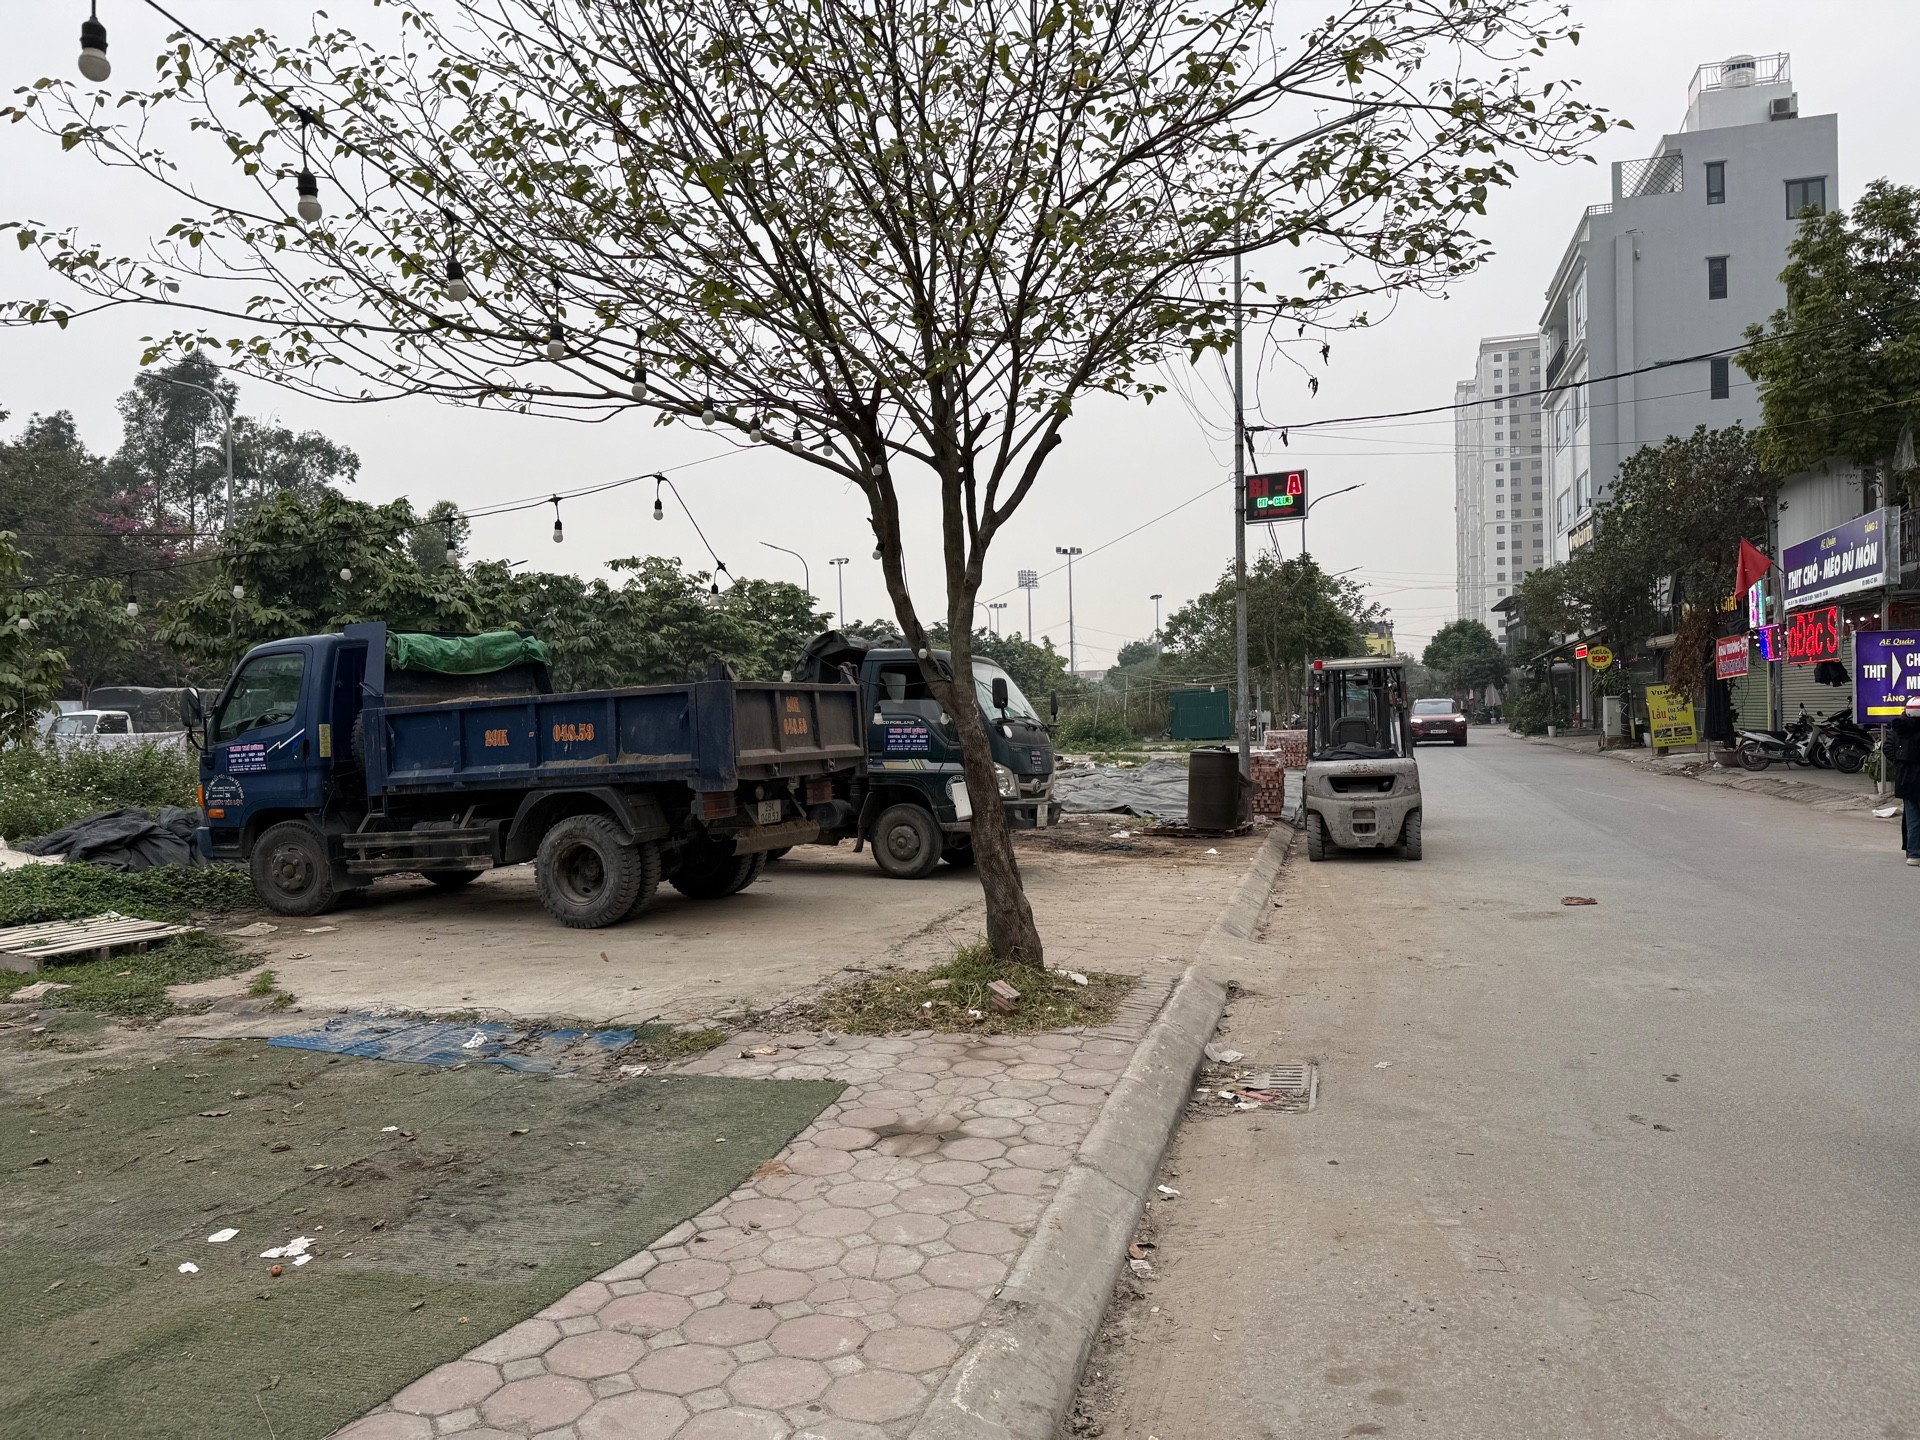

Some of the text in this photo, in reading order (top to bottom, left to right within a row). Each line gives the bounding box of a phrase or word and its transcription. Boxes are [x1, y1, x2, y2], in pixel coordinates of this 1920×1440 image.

[1249, 479, 1269, 498] BI
[1287, 474, 1302, 494] A
[1788, 569, 1803, 594] THỊT
[1803, 557, 1818, 586] CHÓ
[1823, 551, 1840, 580] MÈO
[1842, 542, 1854, 574] ĐỦ
[1855, 538, 1878, 569] MÓN
[1879, 637, 1915, 646] AE Quán
[1863, 664, 1887, 681] THỊT
[553, 723, 594, 742] 048.53
